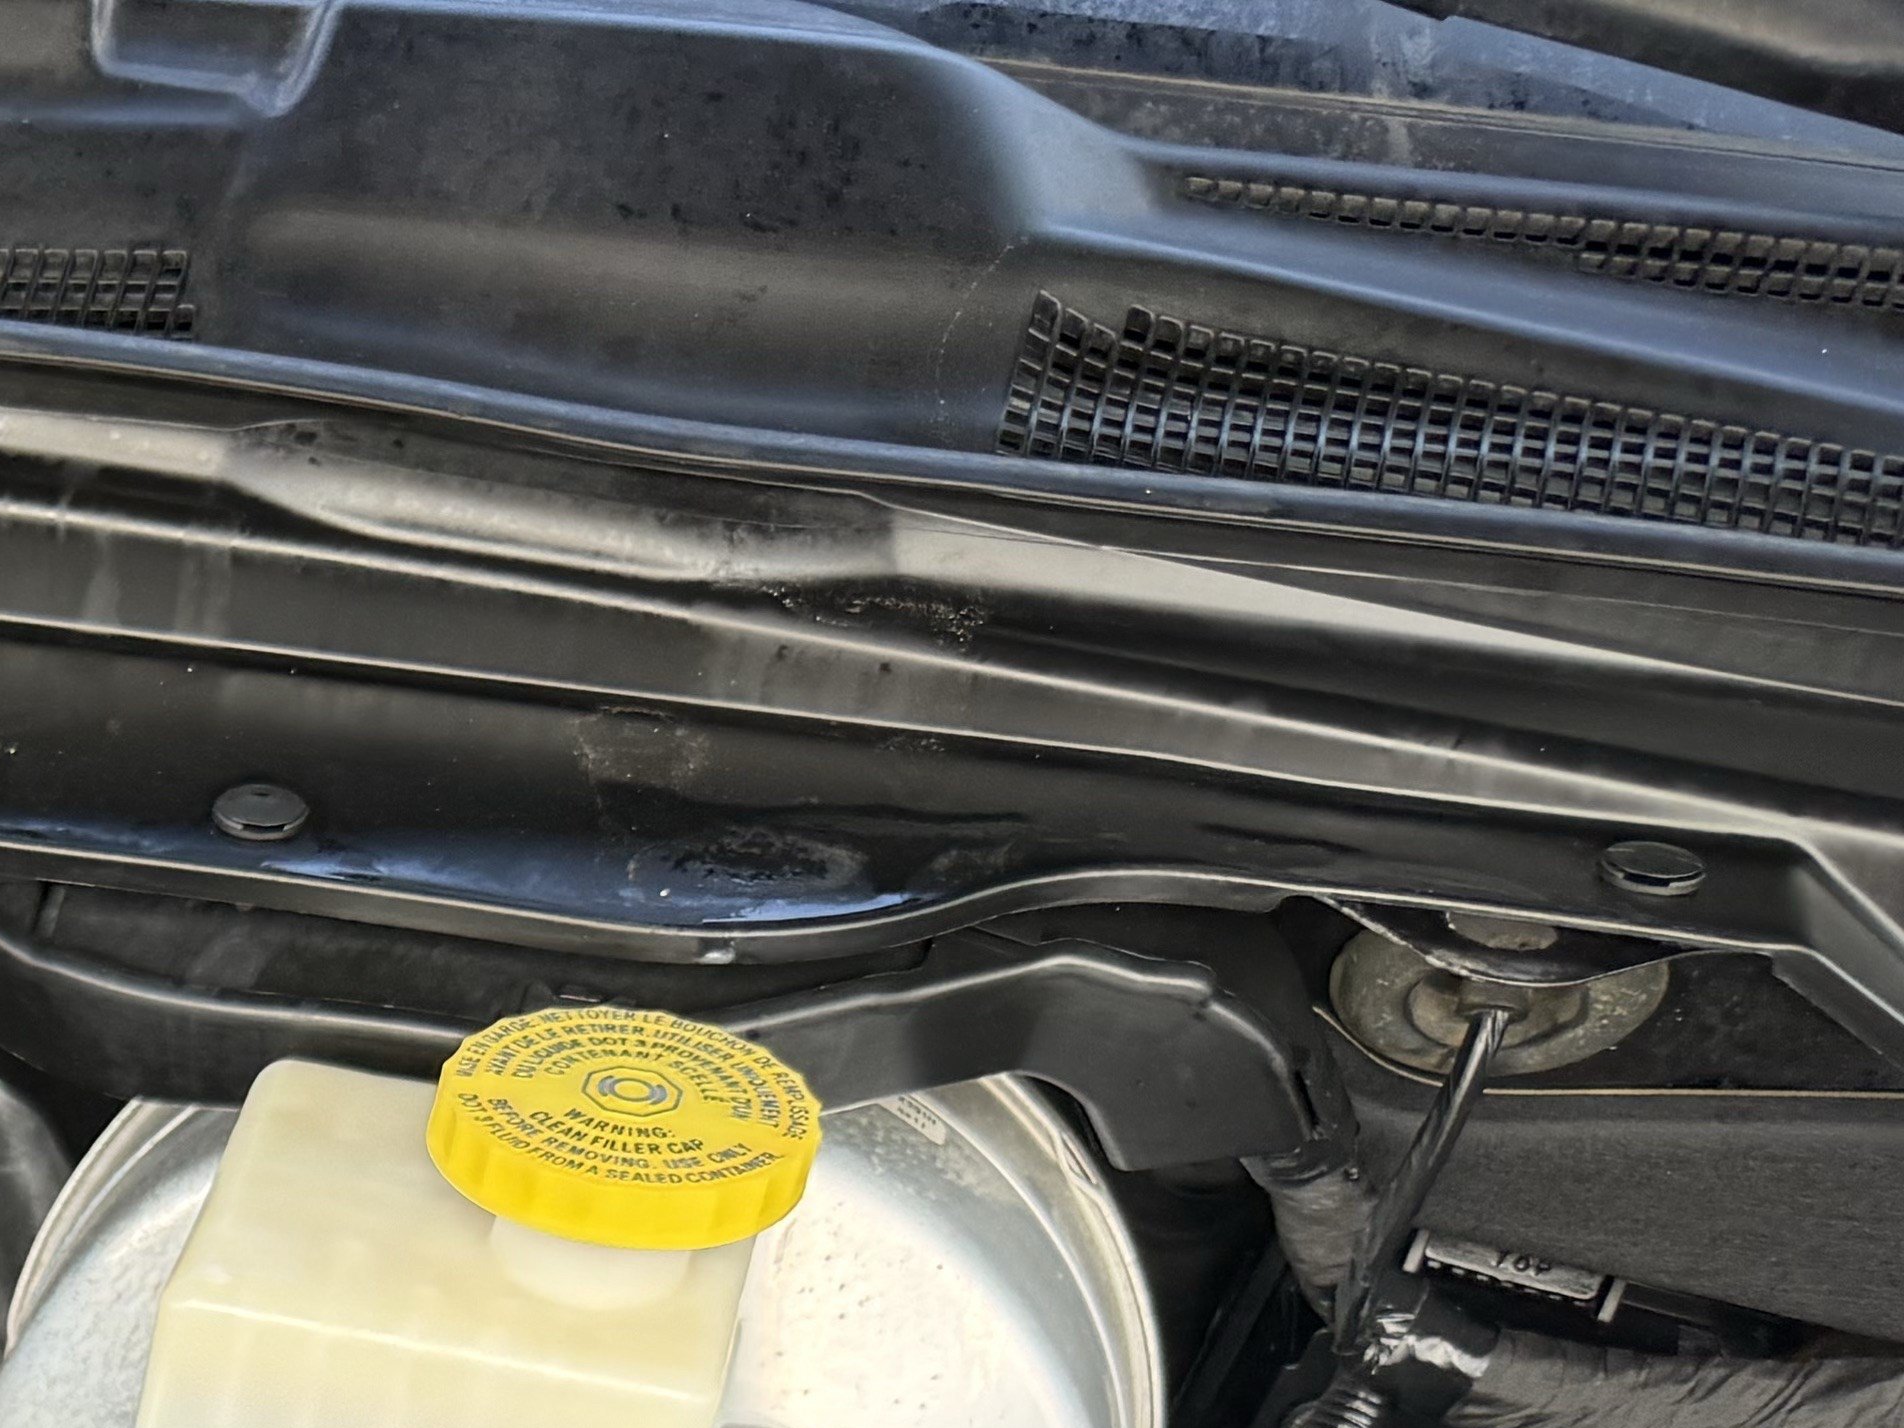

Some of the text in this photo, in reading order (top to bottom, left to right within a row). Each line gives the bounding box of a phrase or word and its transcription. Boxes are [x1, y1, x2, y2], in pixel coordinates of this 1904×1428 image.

[535, 1028, 561, 1041] LE
[653, 1030, 735, 1062] UTILISER
[539, 1009, 636, 1023] NETTOYER
[643, 1014, 667, 1025] LE
[754, 1056, 778, 1070] DE
[588, 1037, 633, 1047] DOT
[543, 1048, 664, 1076] CONTENANT
[458, 1093, 488, 1113] DOT
[487, 1122, 531, 1149] FLUID
[526, 1147, 584, 1170] FROM
[585, 1165, 598, 1175] A
[605, 1169, 683, 1184] SEALED
[488, 1098, 544, 1138] BEFORE
[662, 1156, 705, 1170] USE
[707, 1143, 753, 1163] ONLY
[529, 1111, 704, 1155] CLEAN FILLER CAP
